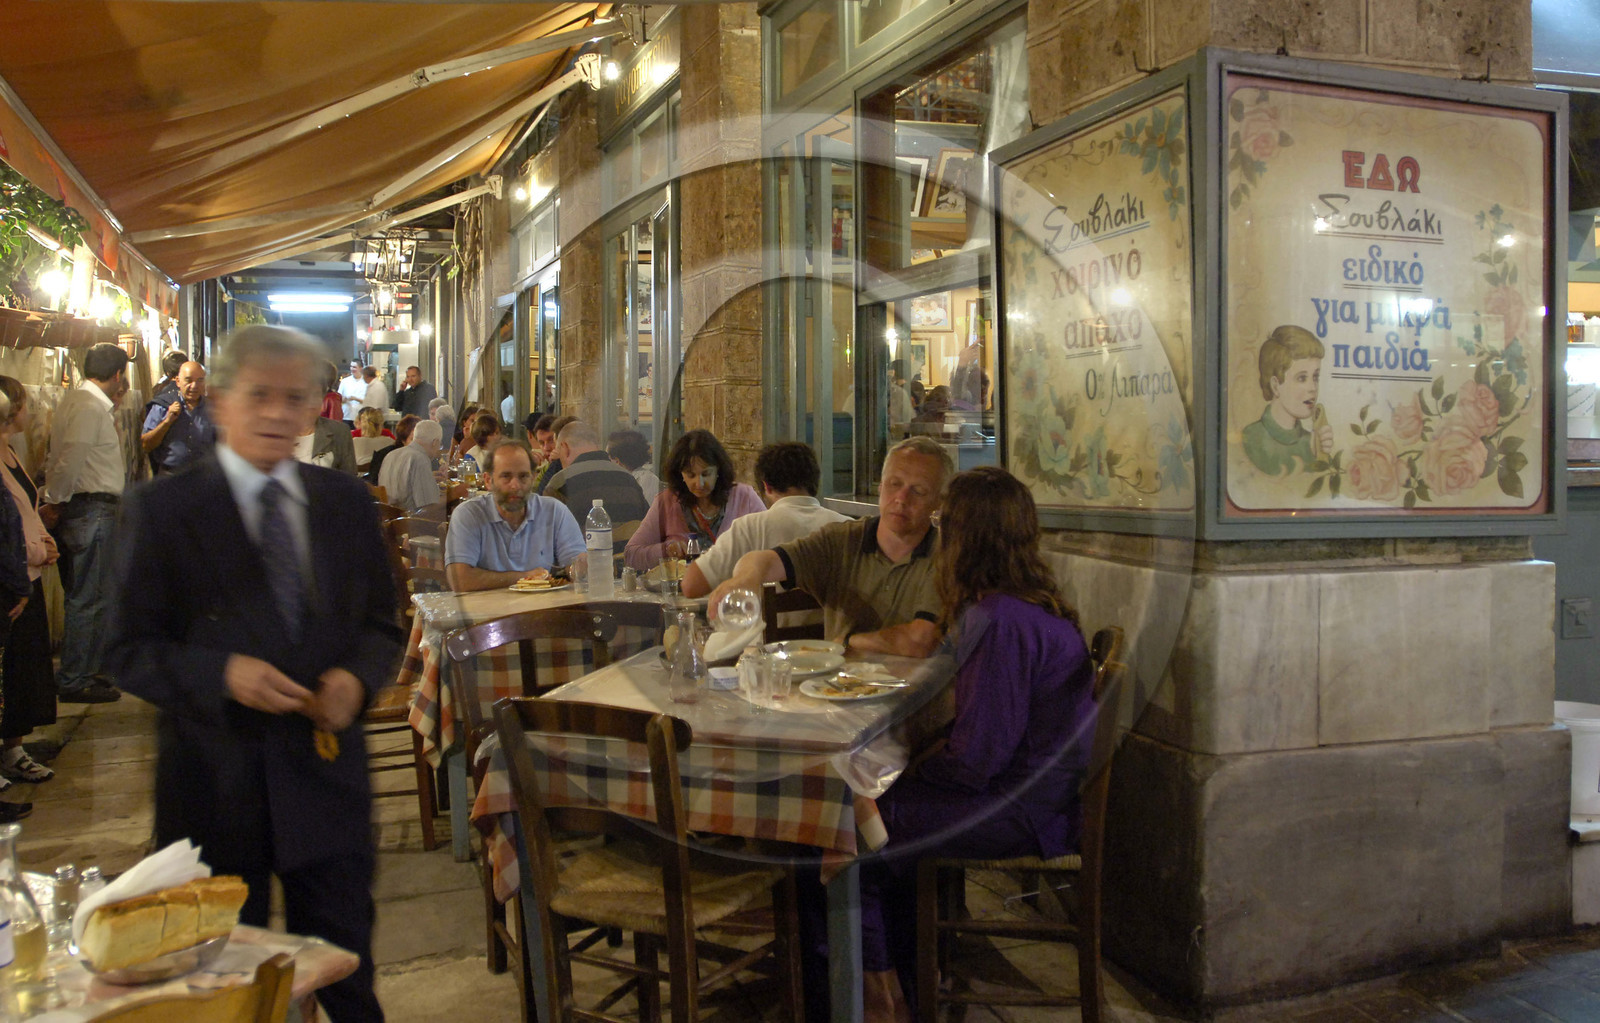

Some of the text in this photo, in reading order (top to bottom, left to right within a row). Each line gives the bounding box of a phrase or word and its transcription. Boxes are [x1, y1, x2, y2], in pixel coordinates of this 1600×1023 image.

[1342, 150, 1421, 193] ΕΔΩ
[1043, 192, 1145, 253] Σουβλάκι
[1317, 193, 1442, 234] Σουβλάκι
[1050, 239, 1142, 299] χοιρινό
[1342, 244, 1424, 285] ειδικό
[1311, 298, 1360, 338] για
[1332, 331, 1432, 372] παιδιά
